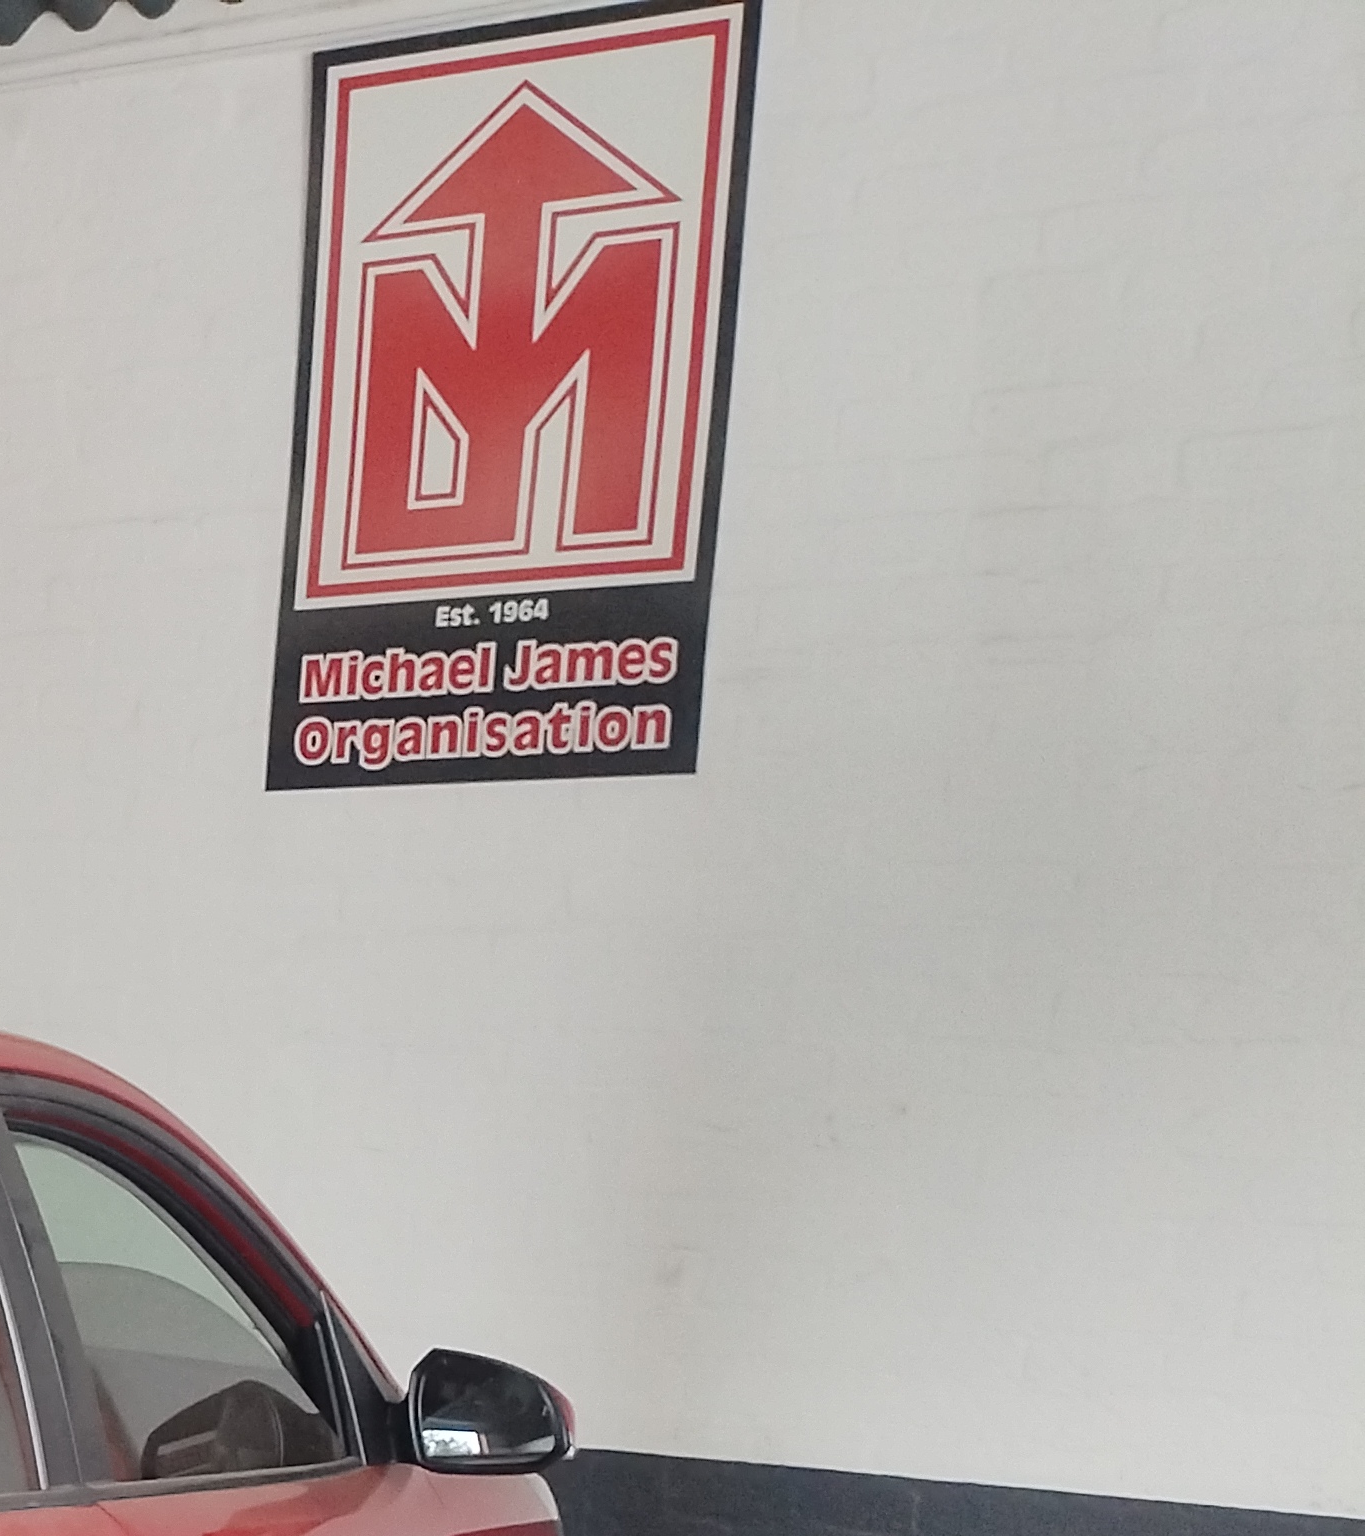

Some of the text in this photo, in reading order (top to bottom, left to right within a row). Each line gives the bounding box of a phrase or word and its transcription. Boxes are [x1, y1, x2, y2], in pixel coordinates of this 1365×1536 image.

[435, 598, 550, 628] Est. 1964
[299, 636, 679, 704] Michael James
[295, 699, 672, 771] Organisation
